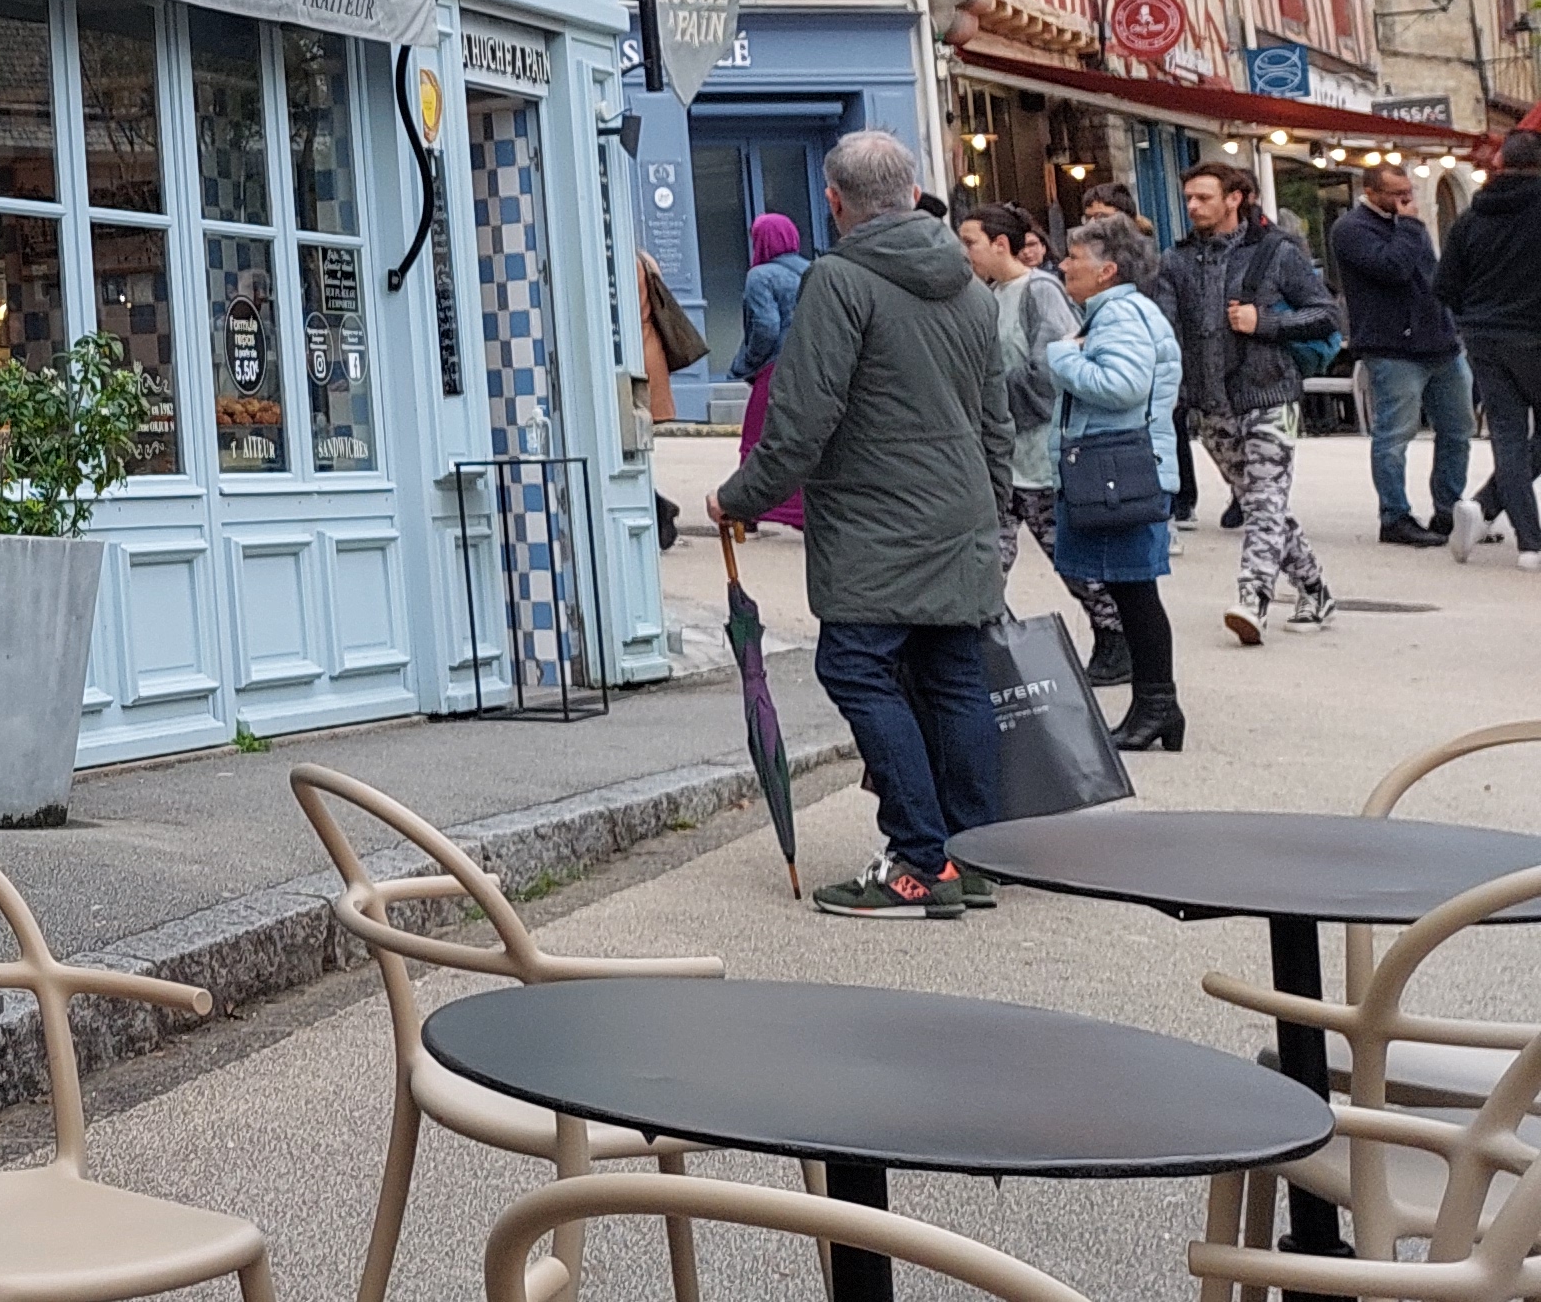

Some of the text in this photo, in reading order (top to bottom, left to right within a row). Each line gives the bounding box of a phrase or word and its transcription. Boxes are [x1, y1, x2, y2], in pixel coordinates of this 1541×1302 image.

[471, 33, 514, 75] HUCHE
[230, 434, 277, 459] TAITEUR
[318, 436, 370, 459] SANDWICHES
